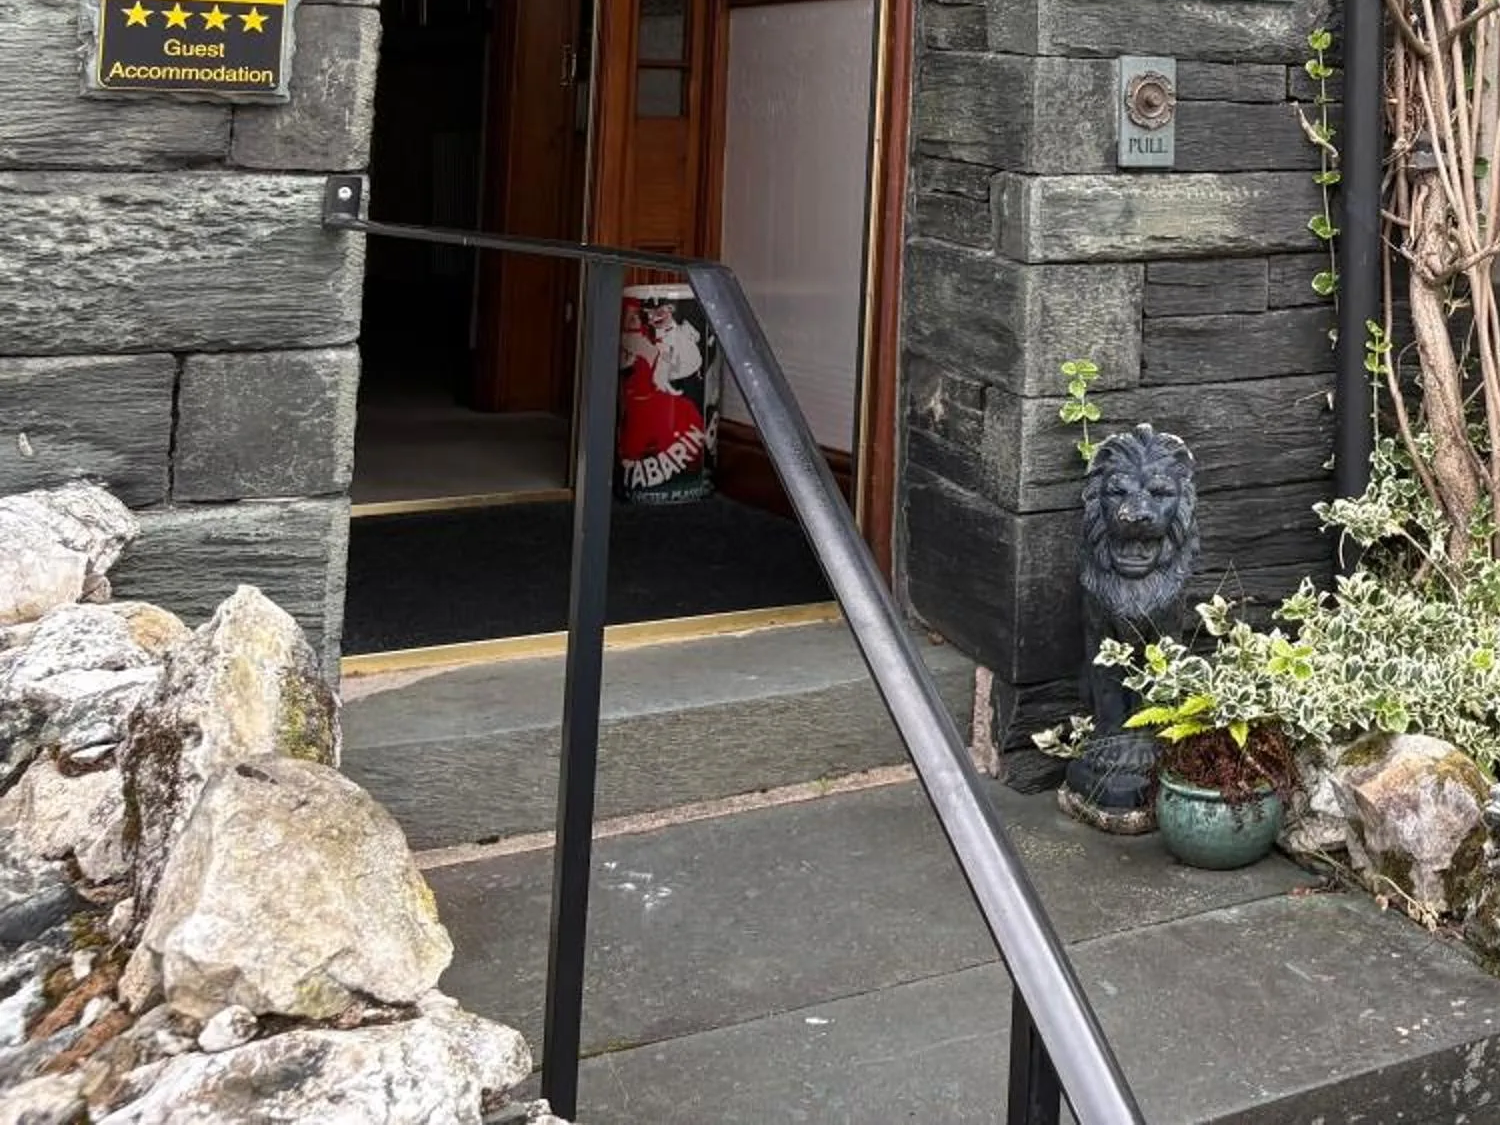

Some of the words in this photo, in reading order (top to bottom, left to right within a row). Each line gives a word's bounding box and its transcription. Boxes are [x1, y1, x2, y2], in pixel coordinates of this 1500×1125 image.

[163, 38, 225, 58] Guest
[109, 61, 274, 84] Accommodation
[1129, 137, 1168, 154] PULL
